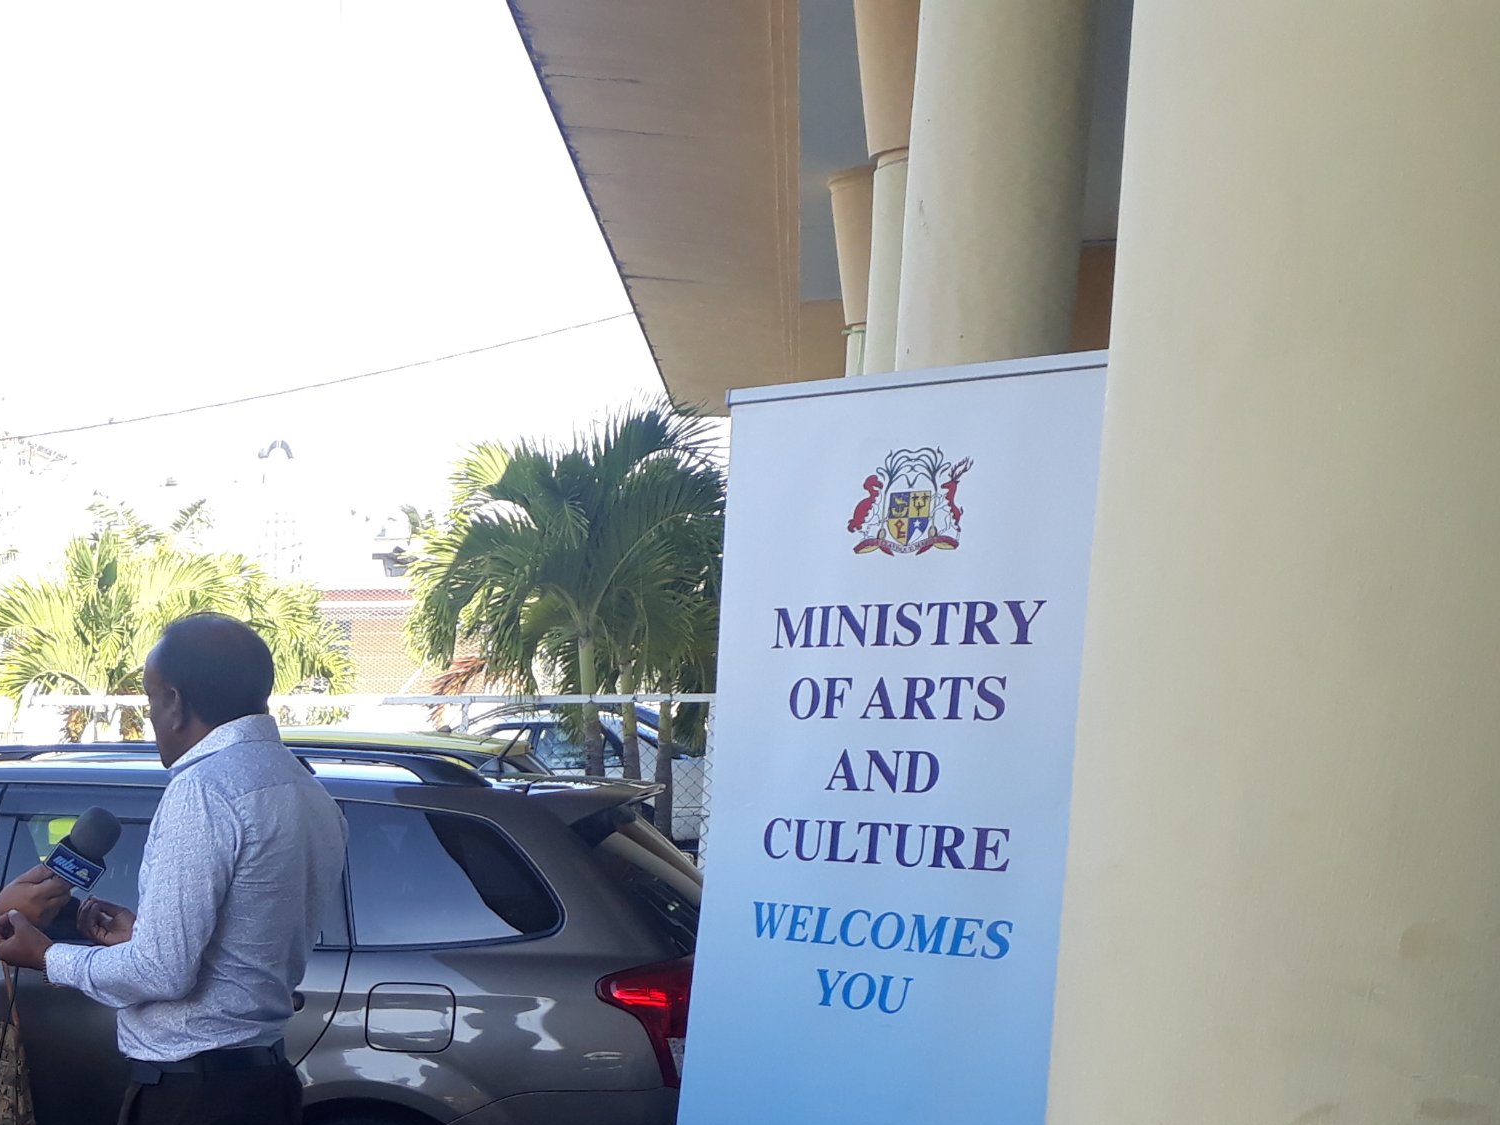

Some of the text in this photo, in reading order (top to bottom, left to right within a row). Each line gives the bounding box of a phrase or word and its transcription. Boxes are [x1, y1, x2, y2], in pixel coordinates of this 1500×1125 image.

[772, 600, 1047, 648] MINISTRY
[790, 676, 1006, 721] OF ARTS
[825, 749, 939, 793] AND
[764, 818, 1009, 871] CULTURE
[754, 902, 1013, 959] WELCOMES
[817, 969, 913, 1014] YOU
